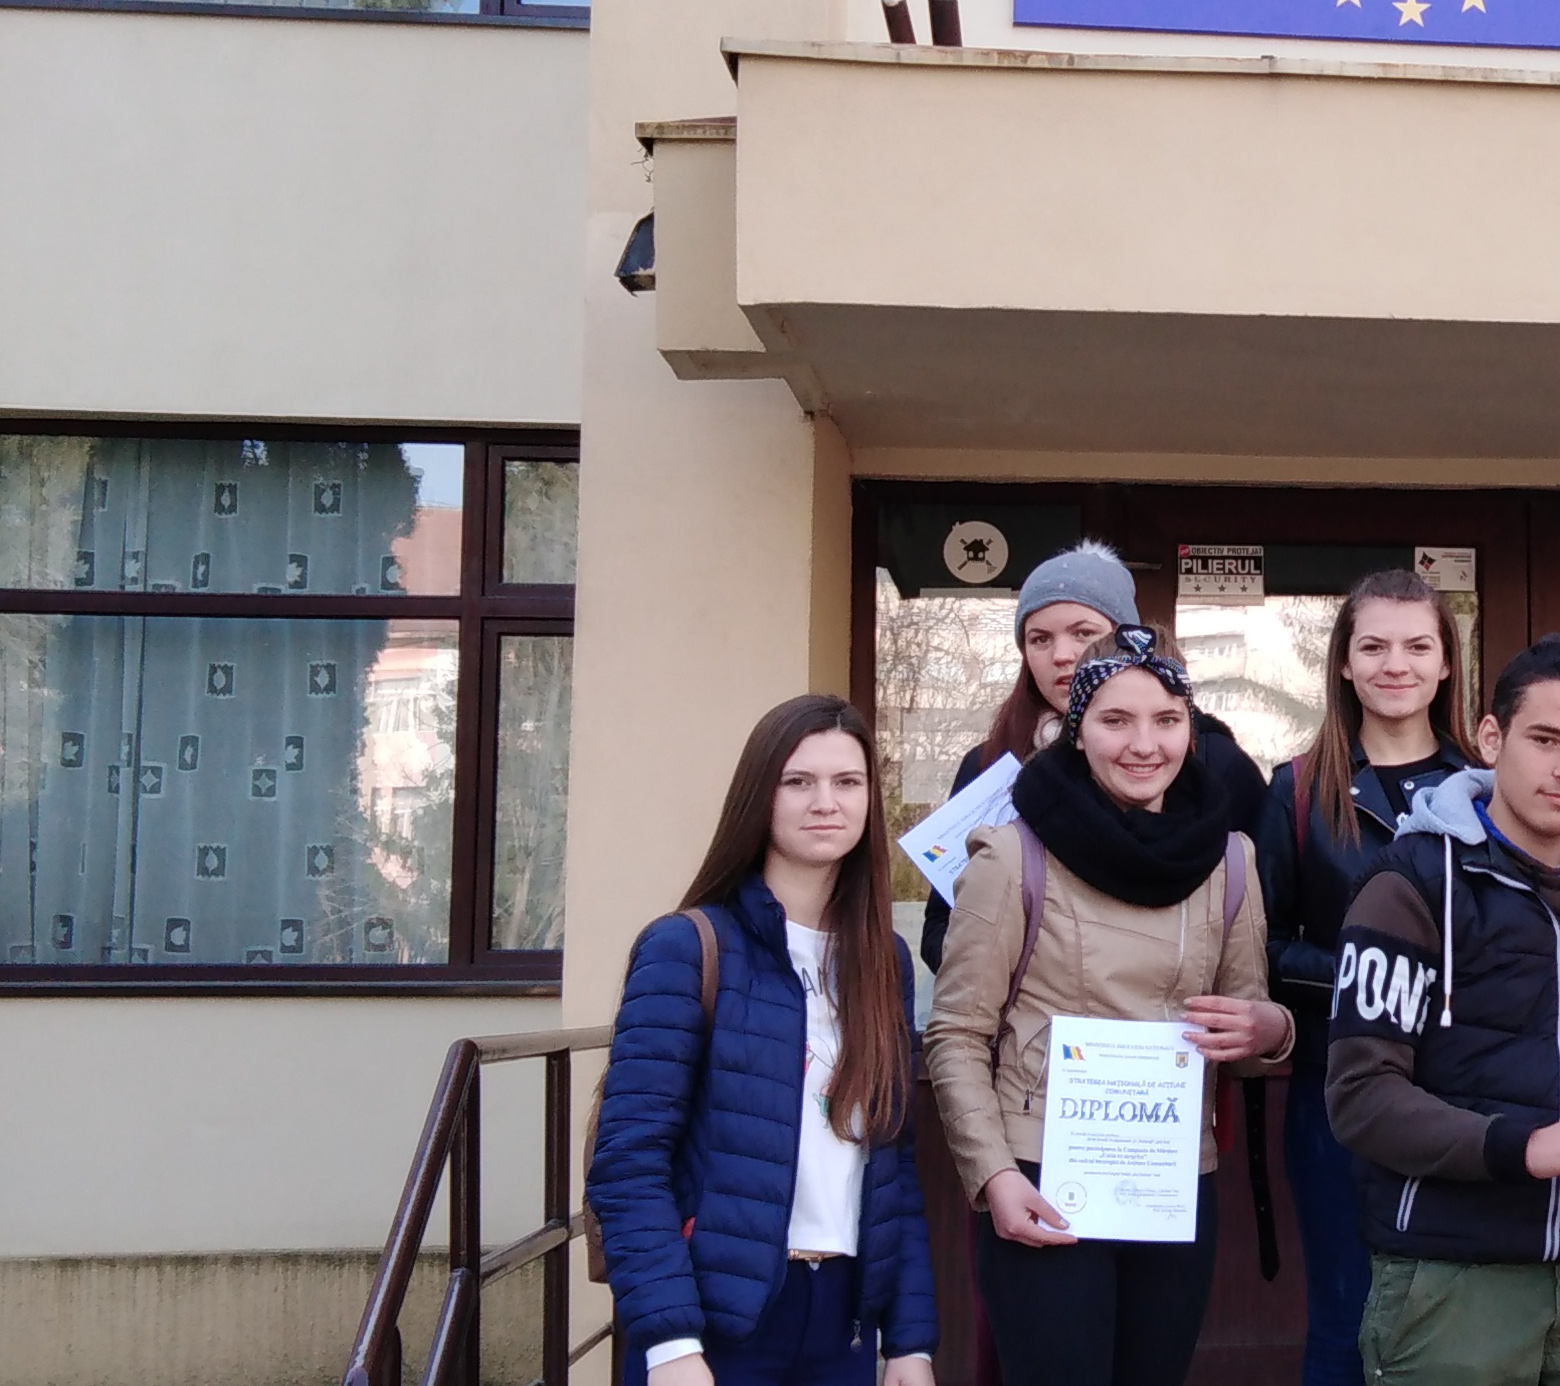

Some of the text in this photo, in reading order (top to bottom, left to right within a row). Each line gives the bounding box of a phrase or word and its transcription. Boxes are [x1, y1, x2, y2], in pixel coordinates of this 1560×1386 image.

[1181, 558, 1261, 574] PILIERUL
[1184, 576, 1257, 584] SECURITY
[1059, 1096, 1181, 1124] DIPLOMĂ
